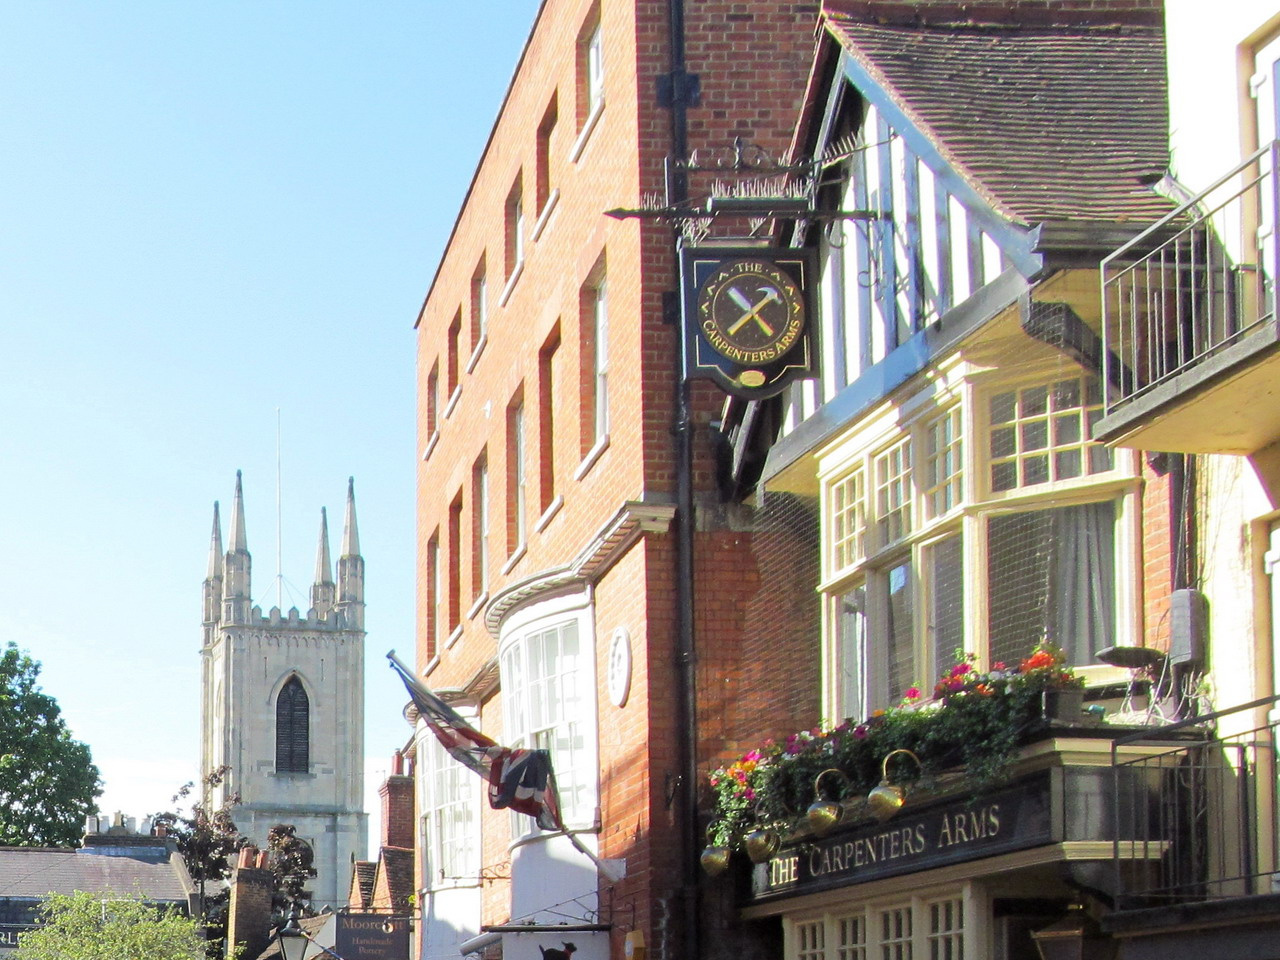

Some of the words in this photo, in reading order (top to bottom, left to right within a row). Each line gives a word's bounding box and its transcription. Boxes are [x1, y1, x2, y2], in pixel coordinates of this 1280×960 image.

[735, 263, 763, 273] THE
[703, 320, 776, 363] CARPENTERS
[775, 319, 801, 354] ARMS
[769, 855, 800, 887] THE
[809, 823, 926, 878] CARPENTERS
[937, 804, 1000, 848] ARMS
[342, 917, 405, 930] Moorcft
